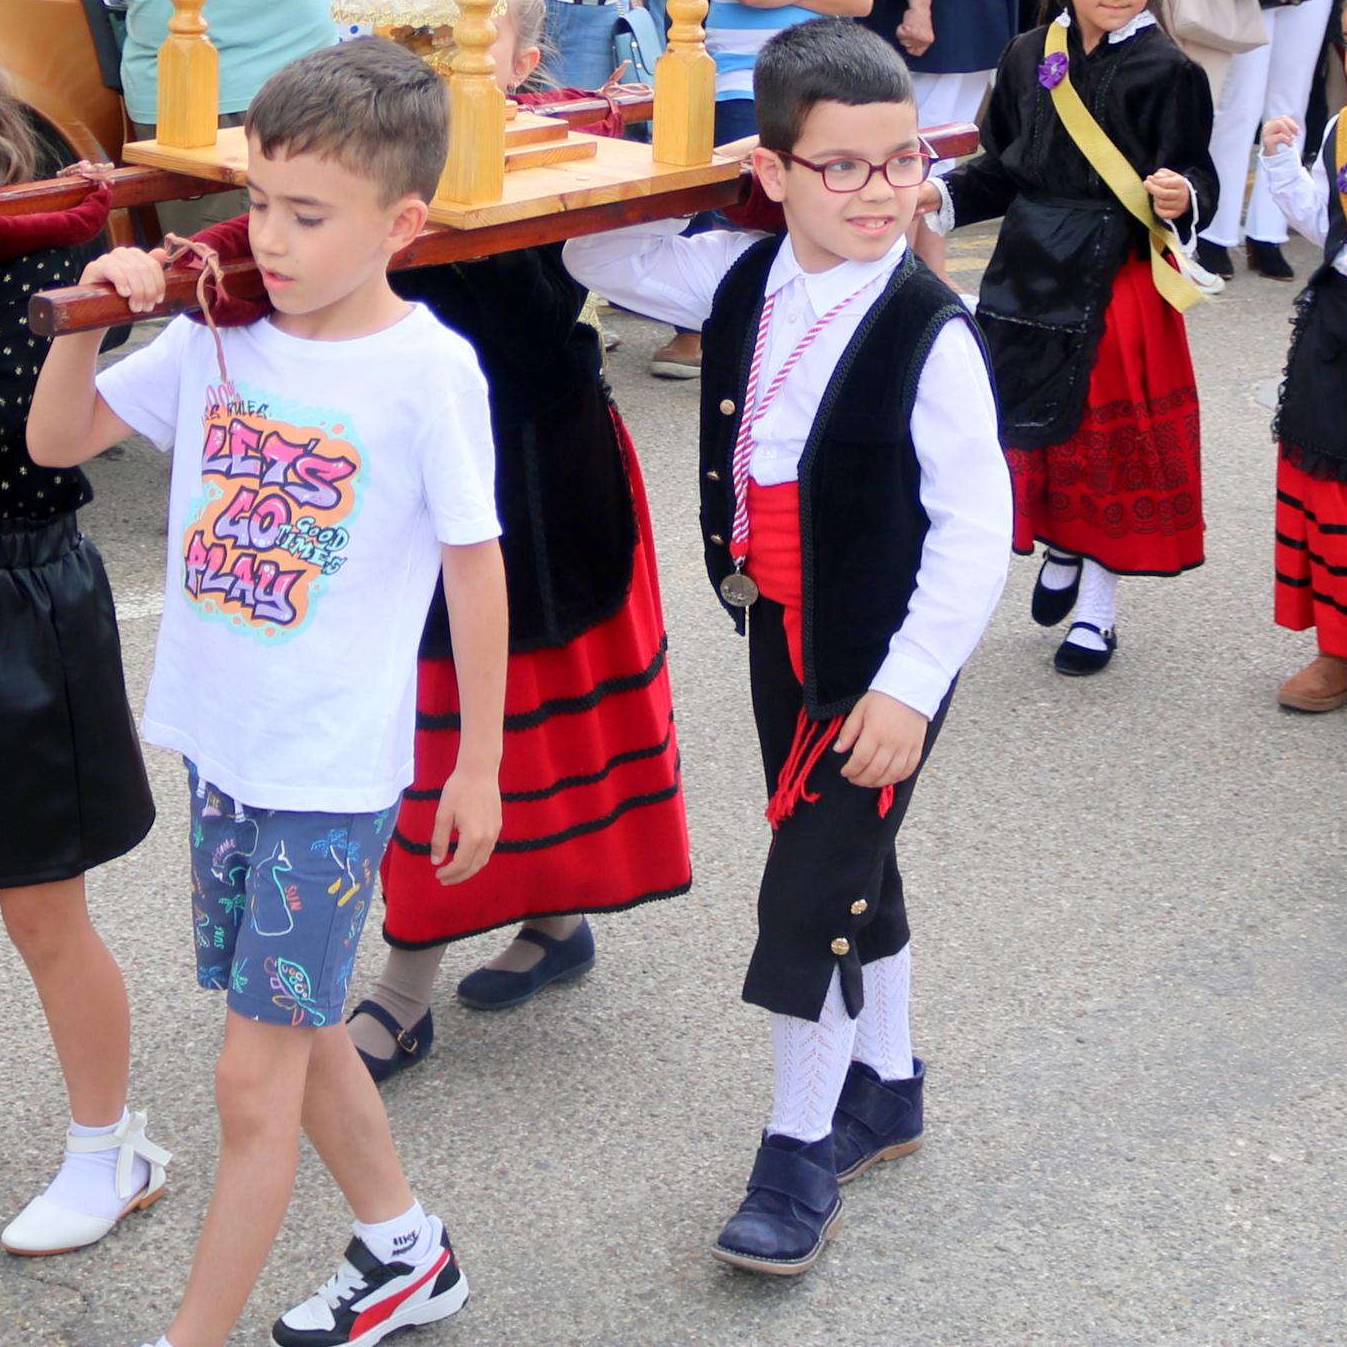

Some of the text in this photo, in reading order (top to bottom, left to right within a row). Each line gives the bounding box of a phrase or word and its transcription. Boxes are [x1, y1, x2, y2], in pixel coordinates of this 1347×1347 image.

[227, 400, 269, 420] RULES
[201, 418, 356, 510] LET'S
[213, 485, 291, 552] GO
[274, 523, 348, 576] TIMES
[185, 529, 307, 626] PLAY
